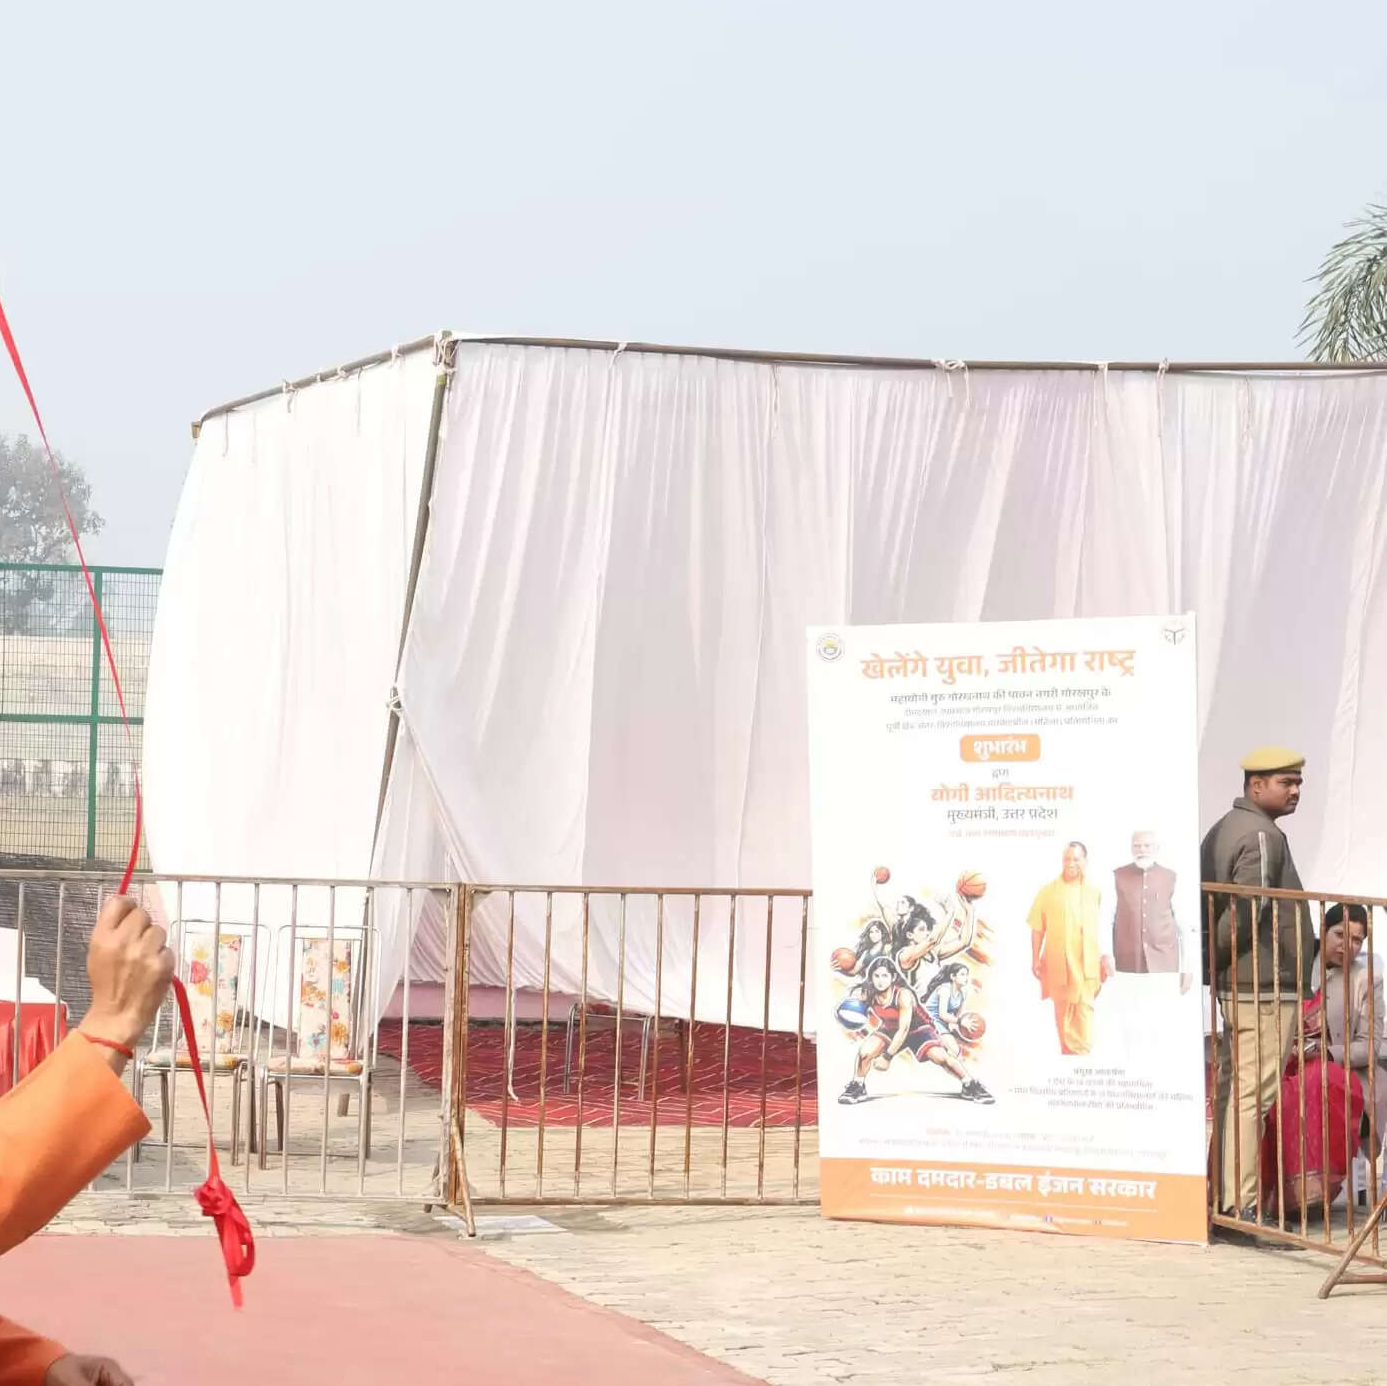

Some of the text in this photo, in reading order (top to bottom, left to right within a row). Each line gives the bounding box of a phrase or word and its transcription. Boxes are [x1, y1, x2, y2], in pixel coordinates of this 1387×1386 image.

[860, 646, 1136, 685] खेलेंगे युवा, जीतेगा राष्ट्र
[974, 737, 1028, 760] शुभारंभ
[930, 782, 1075, 802] योगी आदित्यनाथ
[947, 806, 1058, 825] मुख्यमंत्री, उत्तर प्रदेश
[870, 1167, 913, 1185] काम
[1036, 1170, 1084, 1196] इंजन
[1087, 1178, 1157, 1199] सरकार
